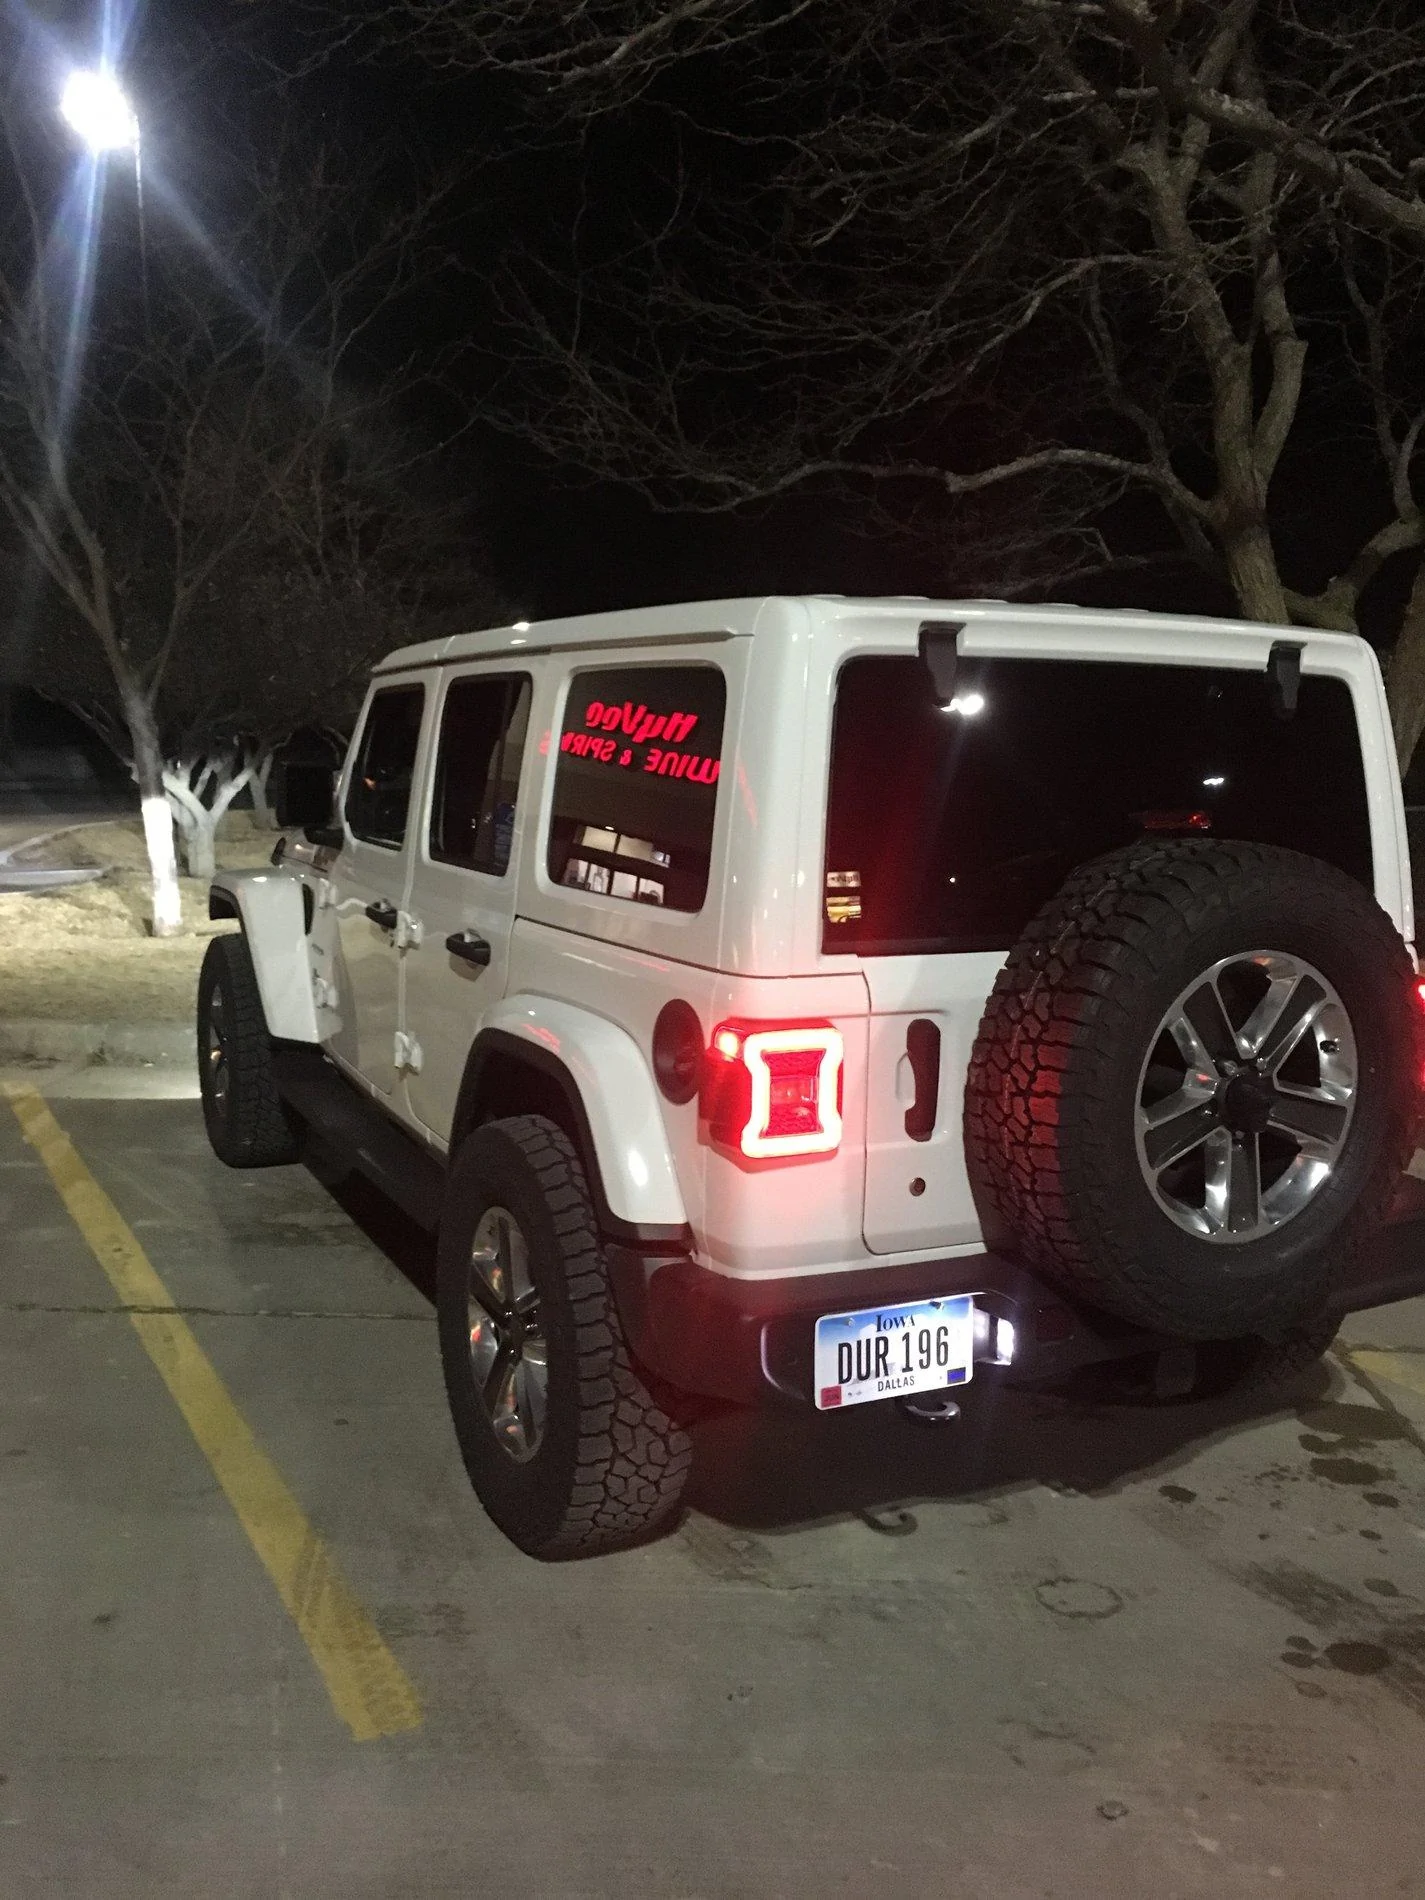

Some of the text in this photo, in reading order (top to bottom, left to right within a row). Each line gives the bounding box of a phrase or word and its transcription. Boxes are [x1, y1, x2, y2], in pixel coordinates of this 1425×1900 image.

[838, 1325, 950, 1385] DUR 196
[877, 1375, 916, 1393] DALLAS
